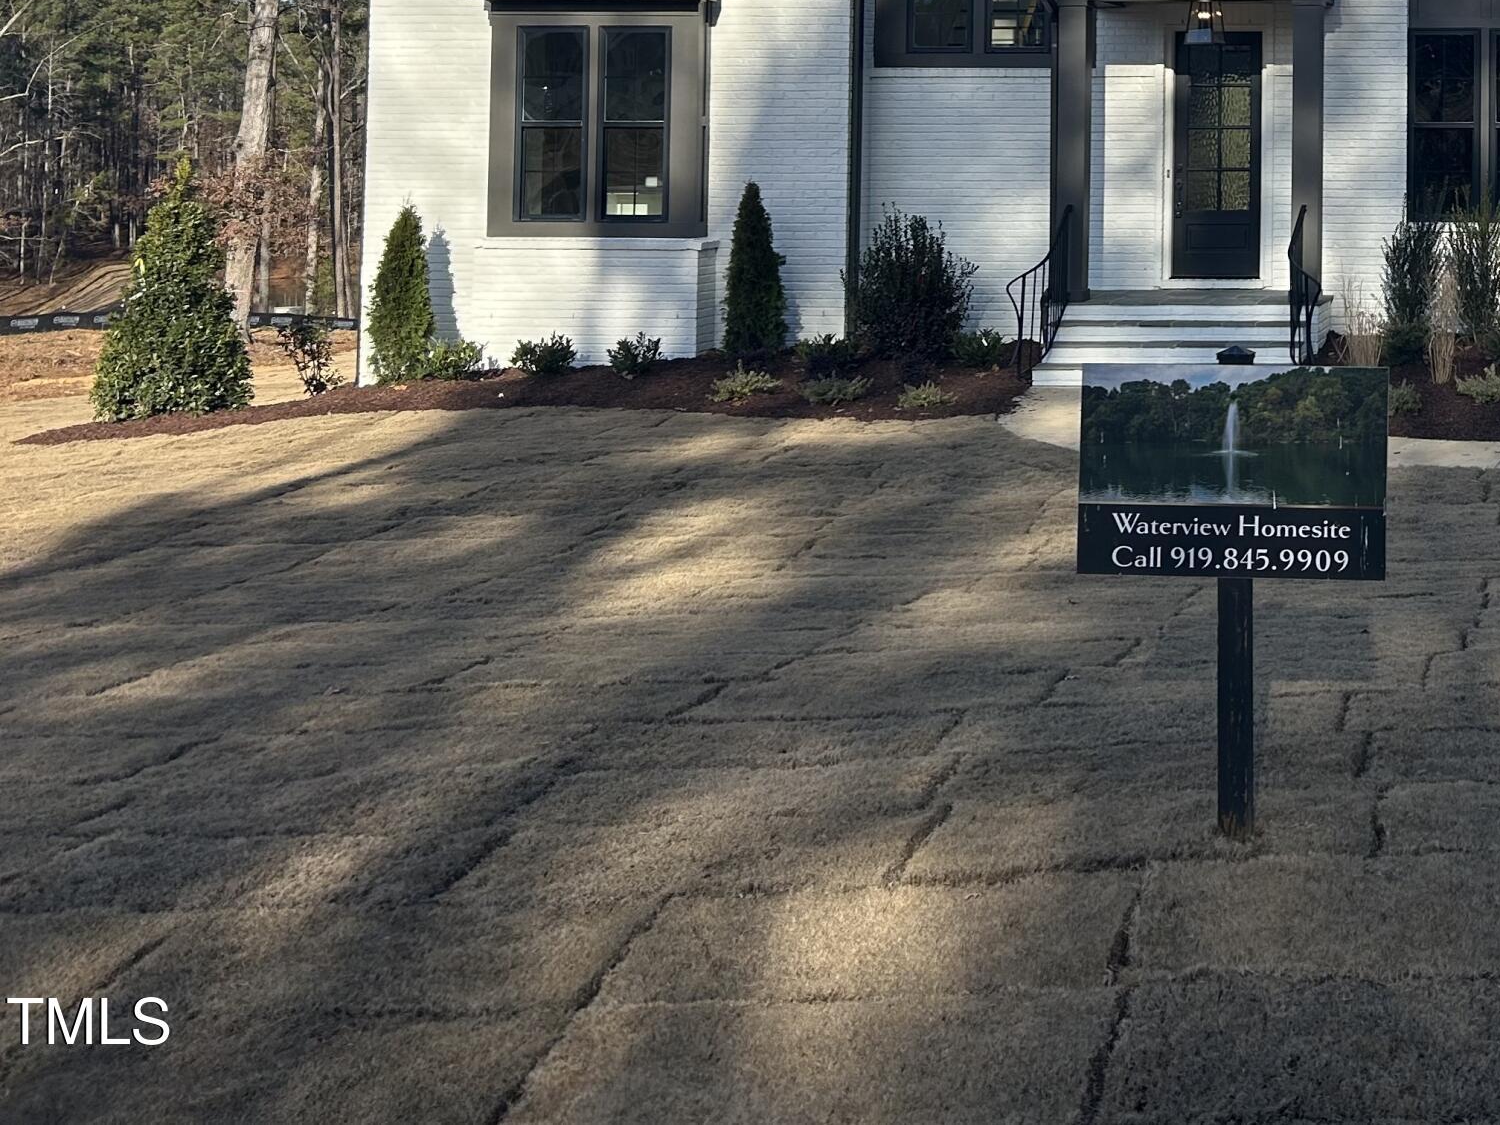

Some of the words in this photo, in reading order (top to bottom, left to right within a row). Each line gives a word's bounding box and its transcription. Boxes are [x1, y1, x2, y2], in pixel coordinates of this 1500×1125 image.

[1111, 511, 1232, 536] Waterview
[1237, 514, 1351, 539] Homesite
[1111, 545, 1163, 568] Call
[1170, 546, 1349, 572] 919.845.9909
